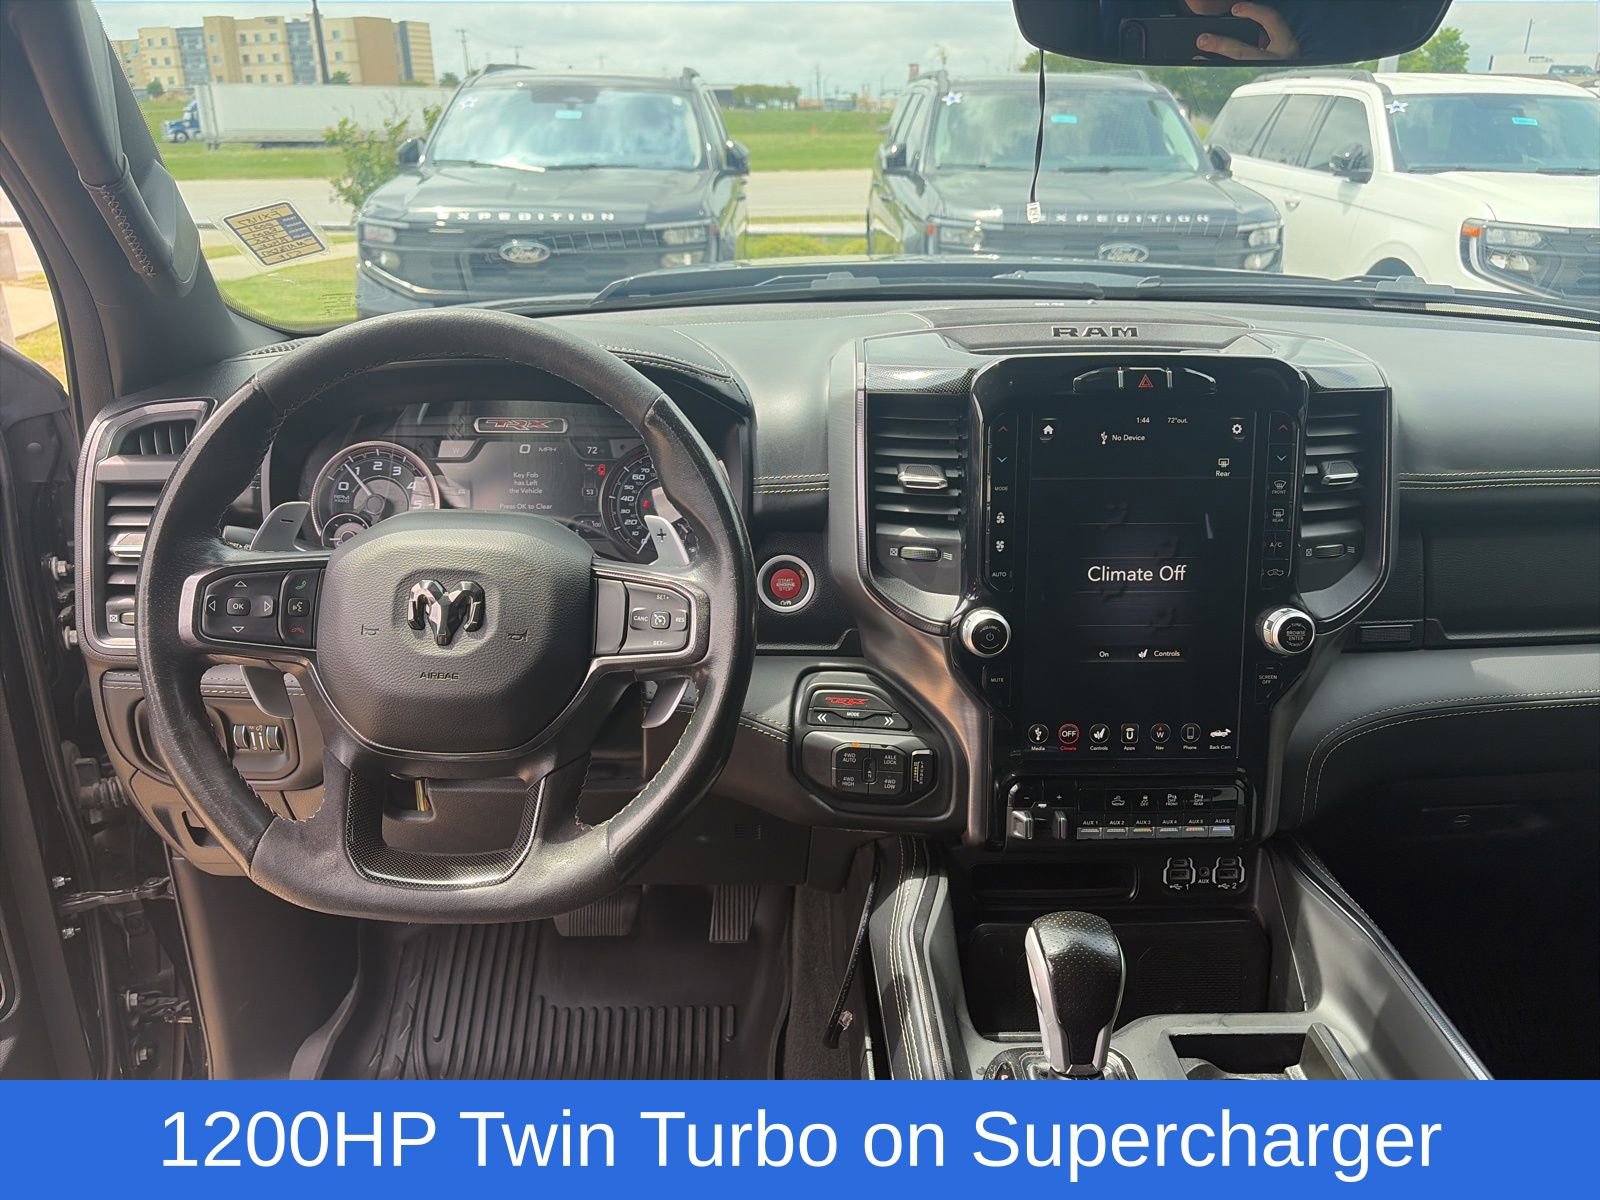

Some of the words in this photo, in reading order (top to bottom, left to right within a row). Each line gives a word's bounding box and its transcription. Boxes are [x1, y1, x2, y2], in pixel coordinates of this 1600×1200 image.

[436, 211, 615, 221] EXPEDITION
[1051, 326, 1139, 338] RAM
[485, 419, 553, 431] TRX
[1112, 434, 1121, 442] No
[1122, 434, 1146, 442] Device
[519, 443, 531, 454] 0
[586, 446, 599, 455] 72
[372, 461, 383, 471] 2
[354, 466, 361, 476] 1
[392, 466, 402, 476] 3
[513, 471, 525, 480] Key
[526, 471, 539, 479] Fob
[1215, 470, 1231, 478] Rear
[338, 481, 350, 491] 0
[406, 481, 416, 491] 4
[513, 479, 526, 487] has
[526, 479, 538, 487] Left
[521, 487, 543, 495] Vehicle
[412, 500, 422, 510] 5
[1087, 565, 1154, 582] Climate
[1158, 564, 1187, 582] Off
[633, 615, 649, 623] CANC
[1099, 650, 1110, 658] On
[1153, 649, 1181, 657] Controls
[419, 672, 459, 680] AIRBAG
[825, 696, 868, 705] TRX
[1061, 730, 1077, 738] OFF
